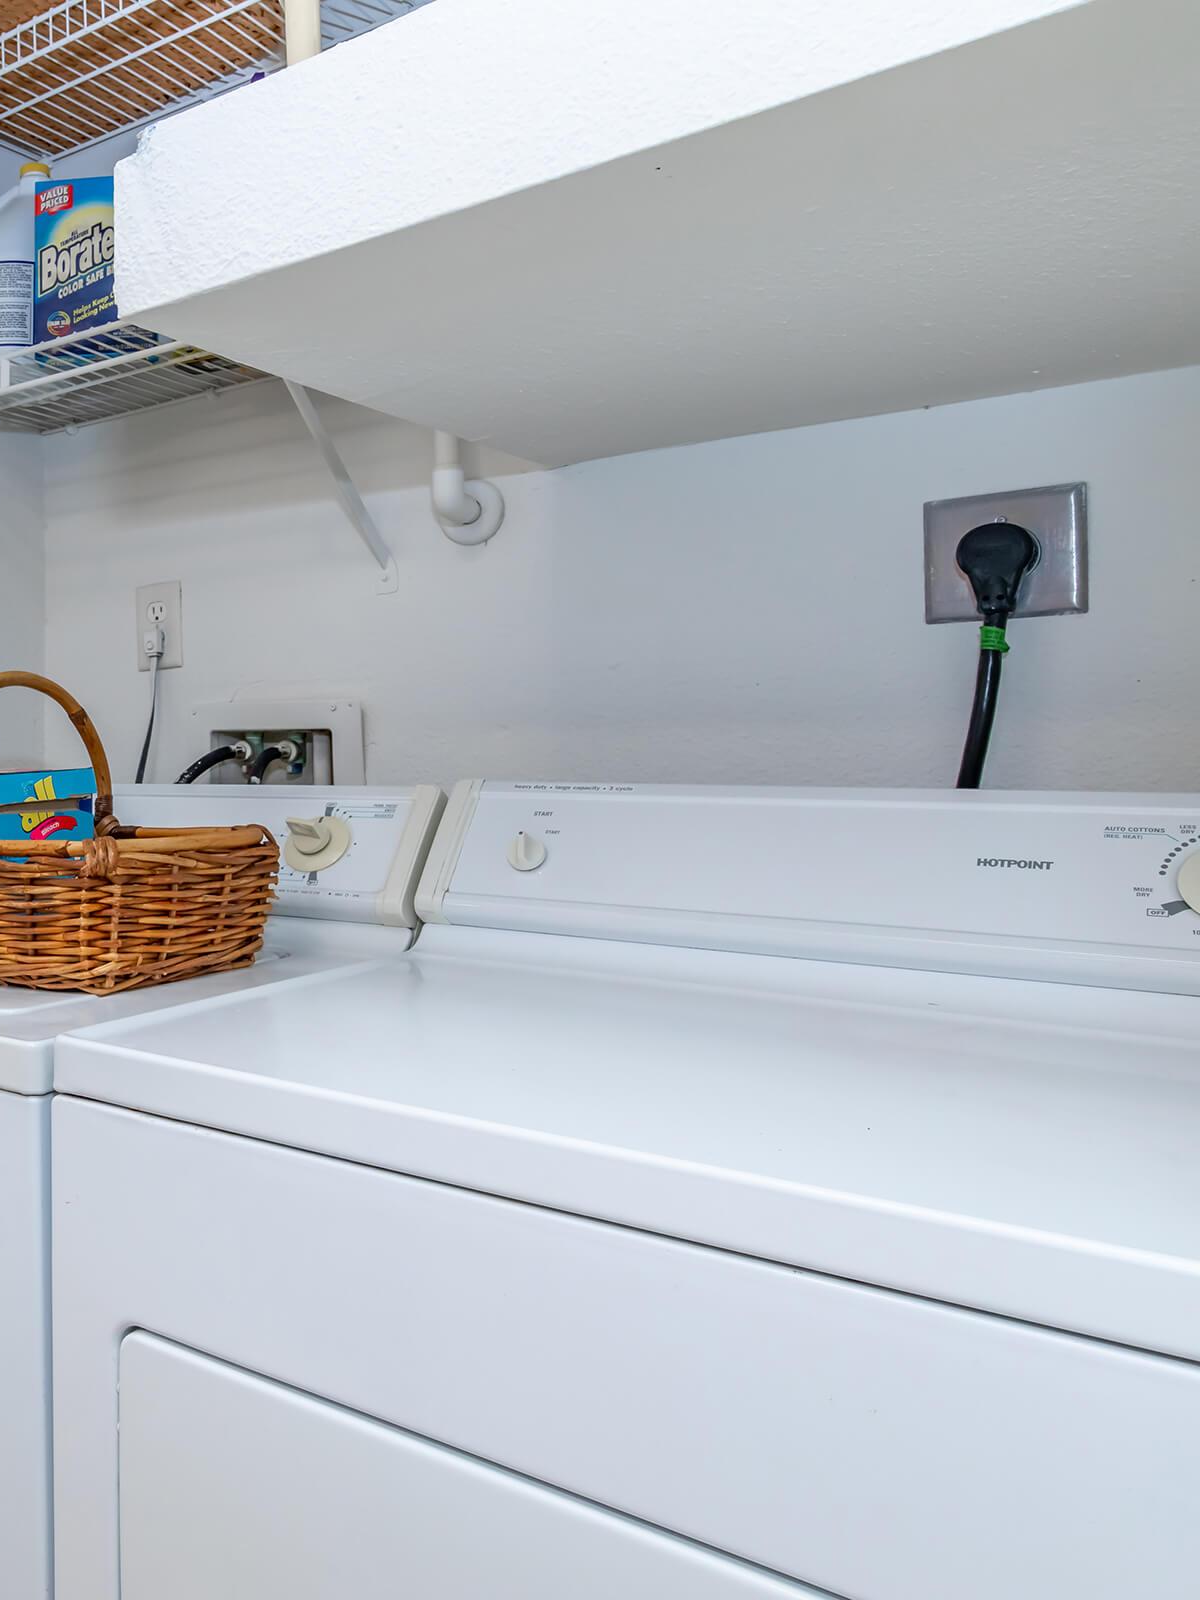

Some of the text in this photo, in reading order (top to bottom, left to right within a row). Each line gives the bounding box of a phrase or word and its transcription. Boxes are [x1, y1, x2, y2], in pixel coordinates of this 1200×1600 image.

[40, 186, 69, 202] VALUE
[40, 195, 69, 212] PRICED
[58, 279, 84, 299] COLOR
[86, 268, 105, 286] SAFE
[73, 304, 91, 316] Helps
[92, 295, 109, 308] Keep
[73, 308, 98, 324] Looking
[976, 857, 1054, 870] HOTPOINT
